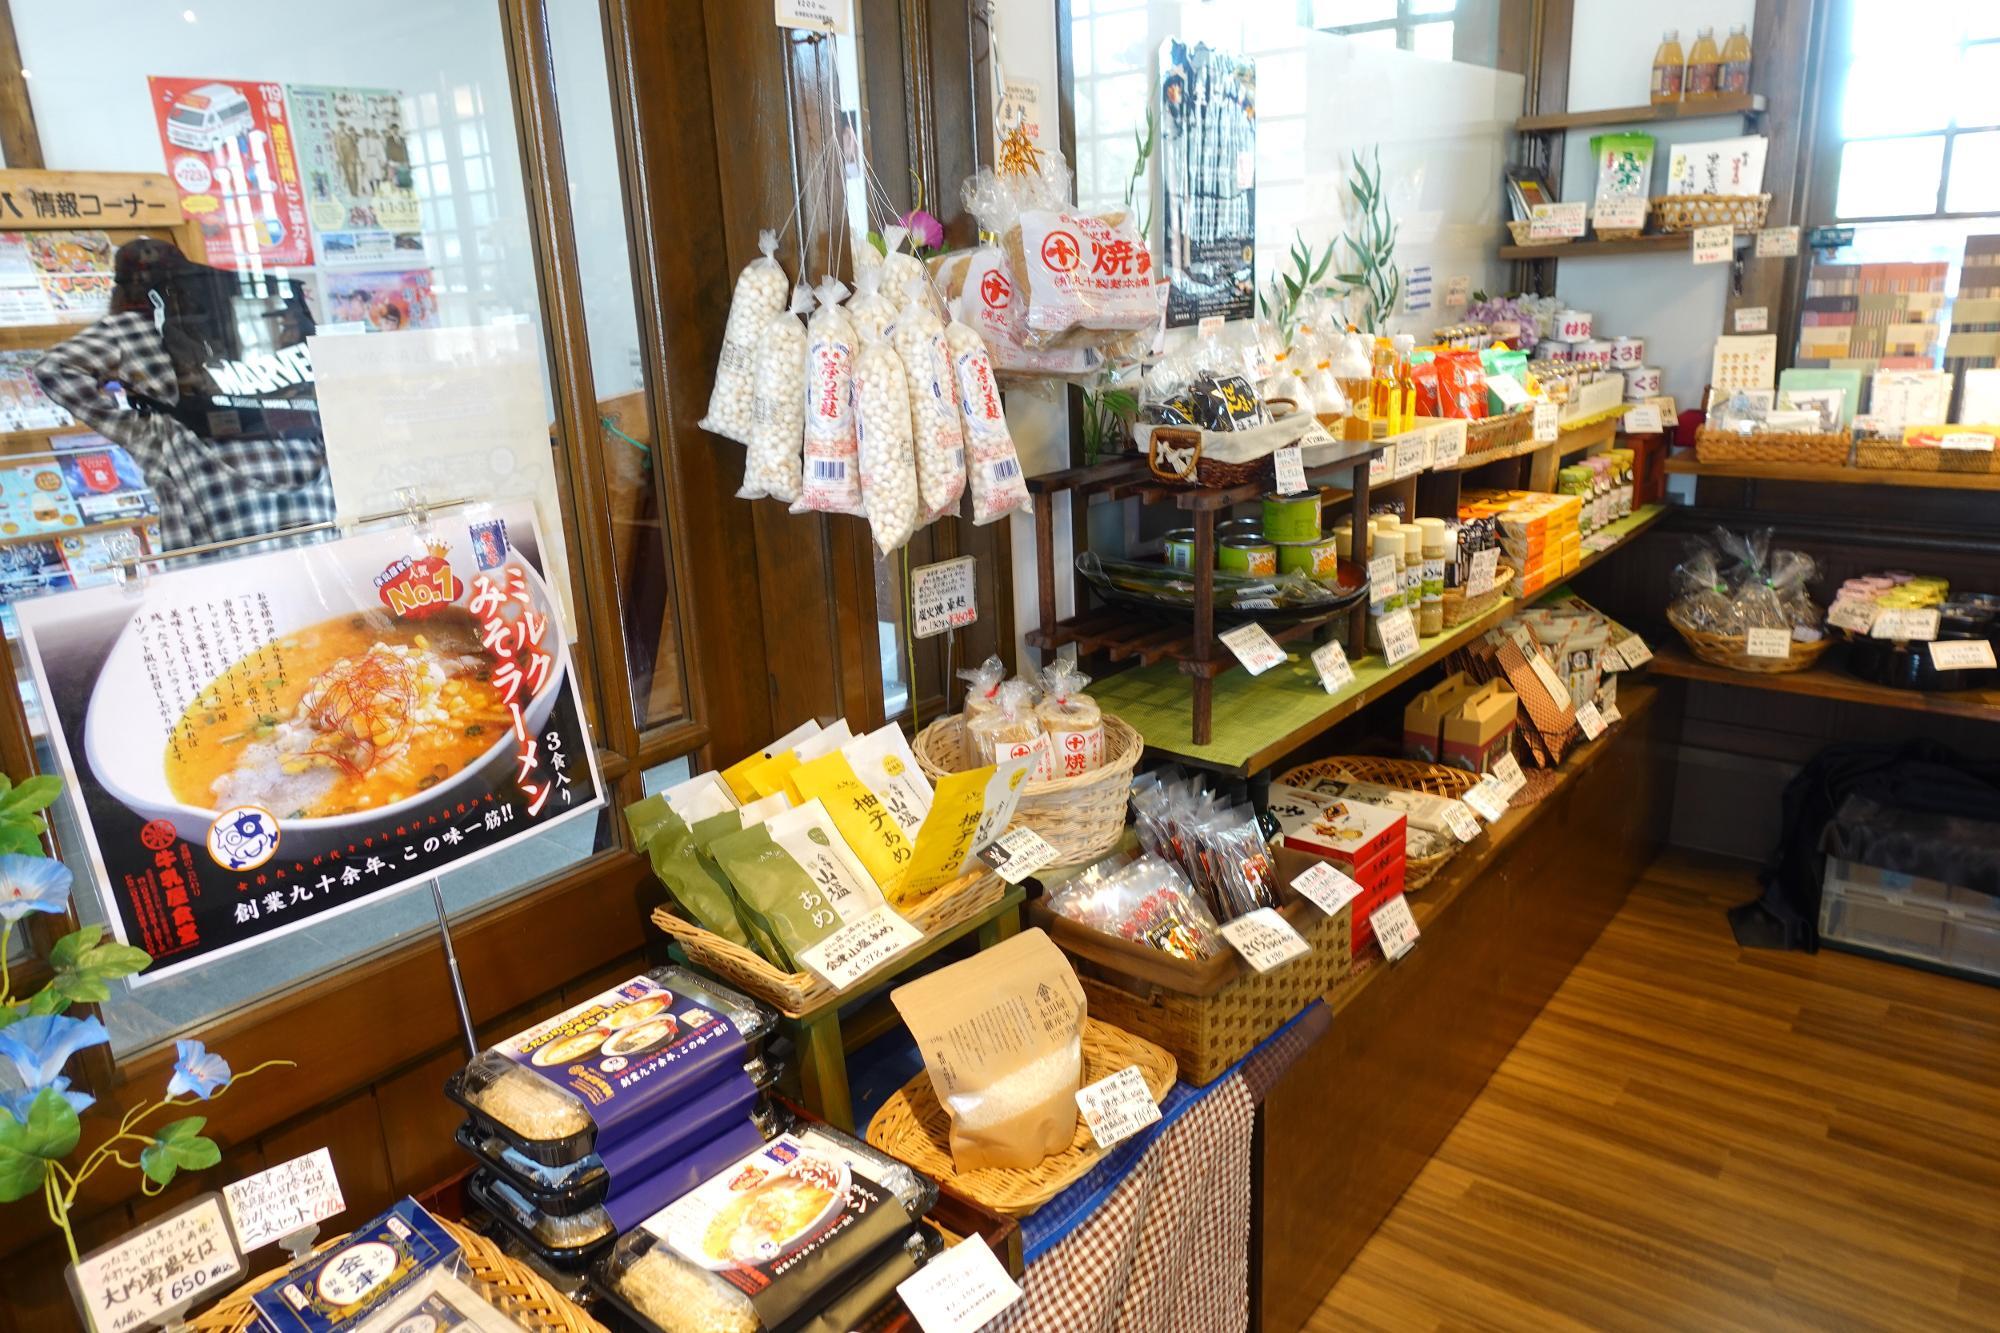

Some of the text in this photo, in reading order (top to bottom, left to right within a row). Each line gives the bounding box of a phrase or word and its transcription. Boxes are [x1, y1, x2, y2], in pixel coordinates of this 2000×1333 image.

[31, 191, 165, 218] 情報コーナー
[203, 342, 315, 396] MARVE
[386, 566, 454, 616] No.1
[408, 565, 428, 581] 人気
[258, 592, 289, 687] お客様の声から生まれた
[507, 567, 551, 696] ミルク
[470, 576, 551, 816] みそラーメン
[546, 731, 571, 804] 3食入り
[853, 794, 911, 864] 柚子あめ
[798, 890, 835, 929] あめ
[816, 869, 851, 902] 山塩
[336, 1254, 380, 1294] 会津
